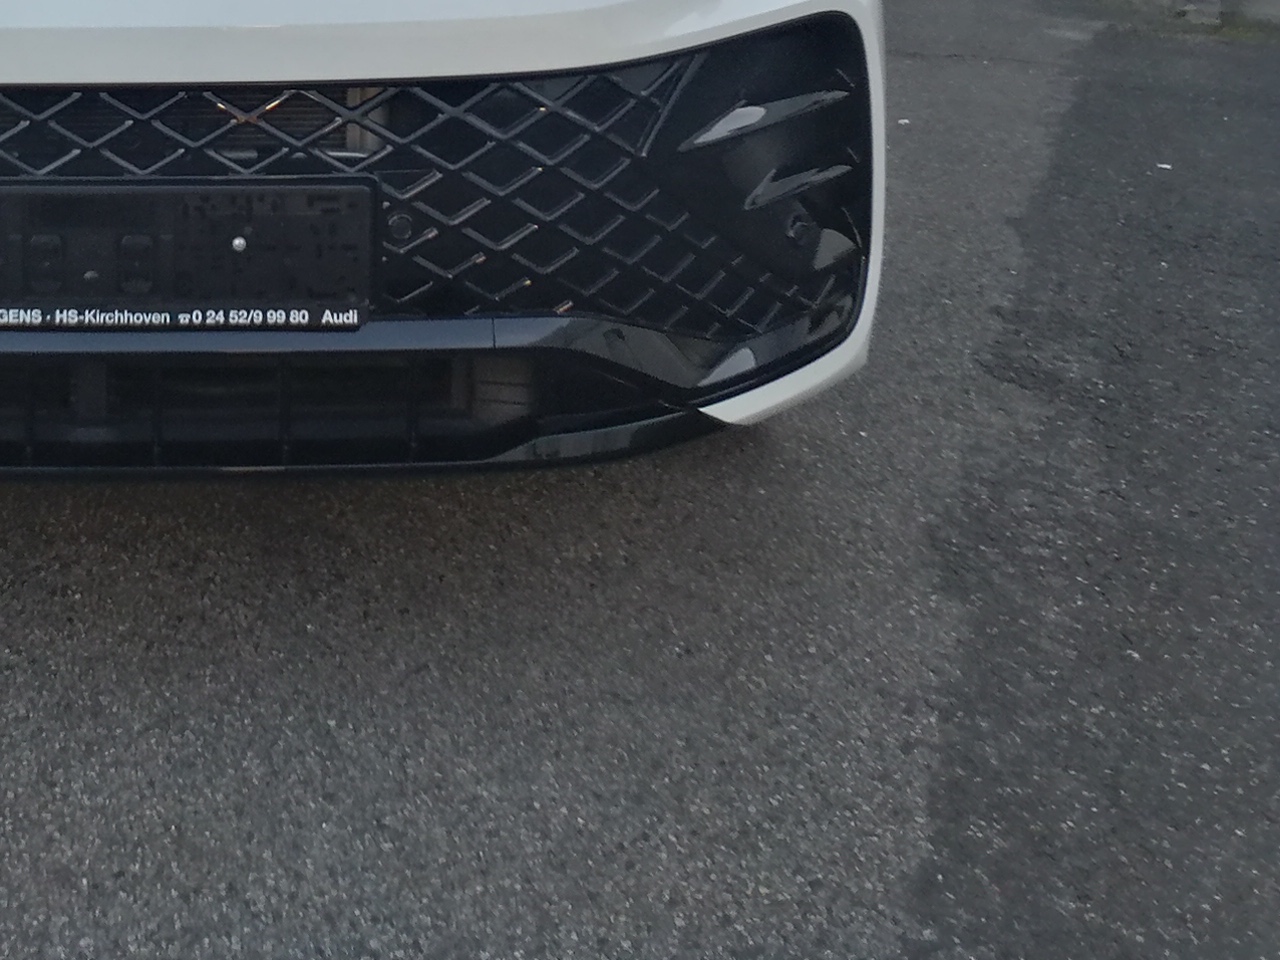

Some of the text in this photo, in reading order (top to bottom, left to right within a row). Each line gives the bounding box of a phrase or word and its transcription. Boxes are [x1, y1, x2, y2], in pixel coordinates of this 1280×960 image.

[55, 308, 171, 325] HS-Kirchhoven
[206, 309, 226, 325] 24
[229, 309, 263, 325] 52/9
[267, 309, 287, 325] 99
[289, 309, 310, 325] 80
[321, 309, 359, 325] Audi
